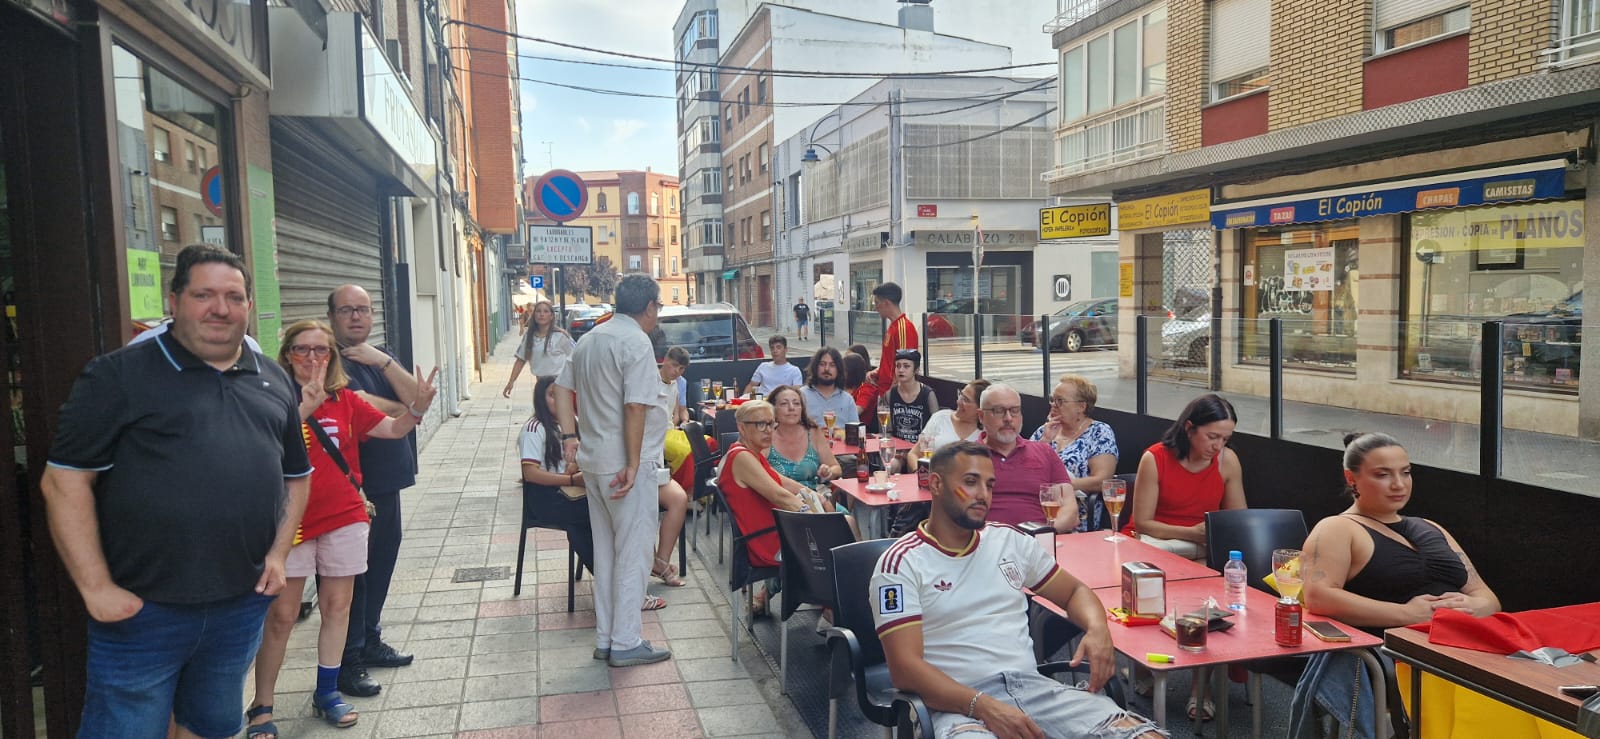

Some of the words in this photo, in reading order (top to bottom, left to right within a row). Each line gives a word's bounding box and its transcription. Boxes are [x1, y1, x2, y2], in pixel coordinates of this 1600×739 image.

[1423, 194, 1455, 205] CHAPAS
[1485, 184, 1534, 198] CAMISETAS
[1145, 204, 1152, 220] El
[1154, 200, 1179, 221] Copión
[1318, 198, 1331, 216] El
[1336, 193, 1382, 217] Copión
[1041, 210, 1054, 225] El
[1059, 206, 1106, 226] Copión
[1462, 223, 1489, 237] COPIA
[1500, 209, 1584, 240] PLANOS
[927, 232, 1000, 244] CALABZO
[533, 278, 541, 287] P
